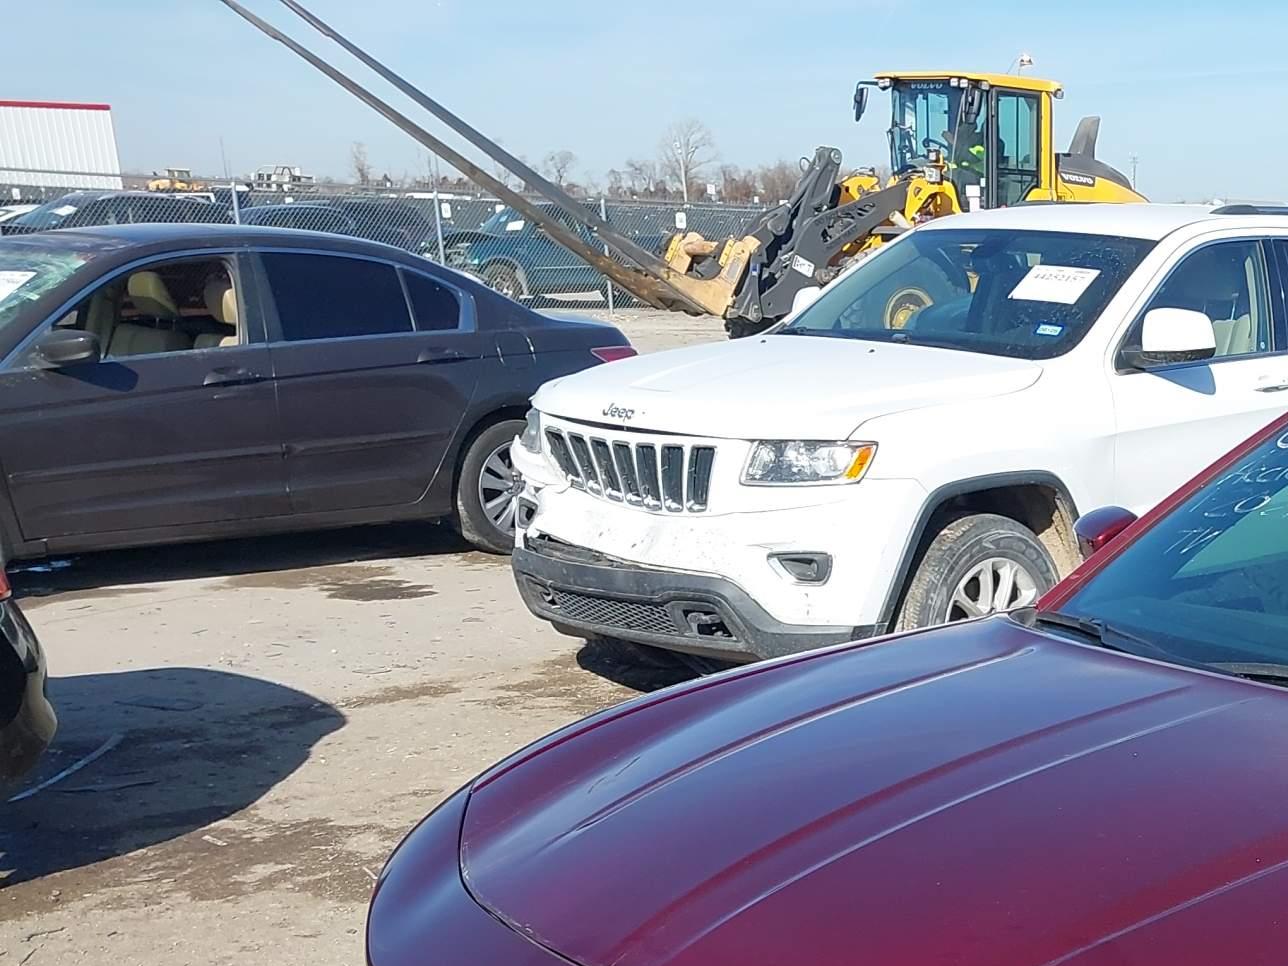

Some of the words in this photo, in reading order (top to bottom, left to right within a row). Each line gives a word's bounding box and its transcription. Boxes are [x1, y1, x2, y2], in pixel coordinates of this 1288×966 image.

[910, 82, 943, 90] VOLVO
[1062, 173, 1095, 184] VOLVO
[602, 402, 635, 422] Jeep
